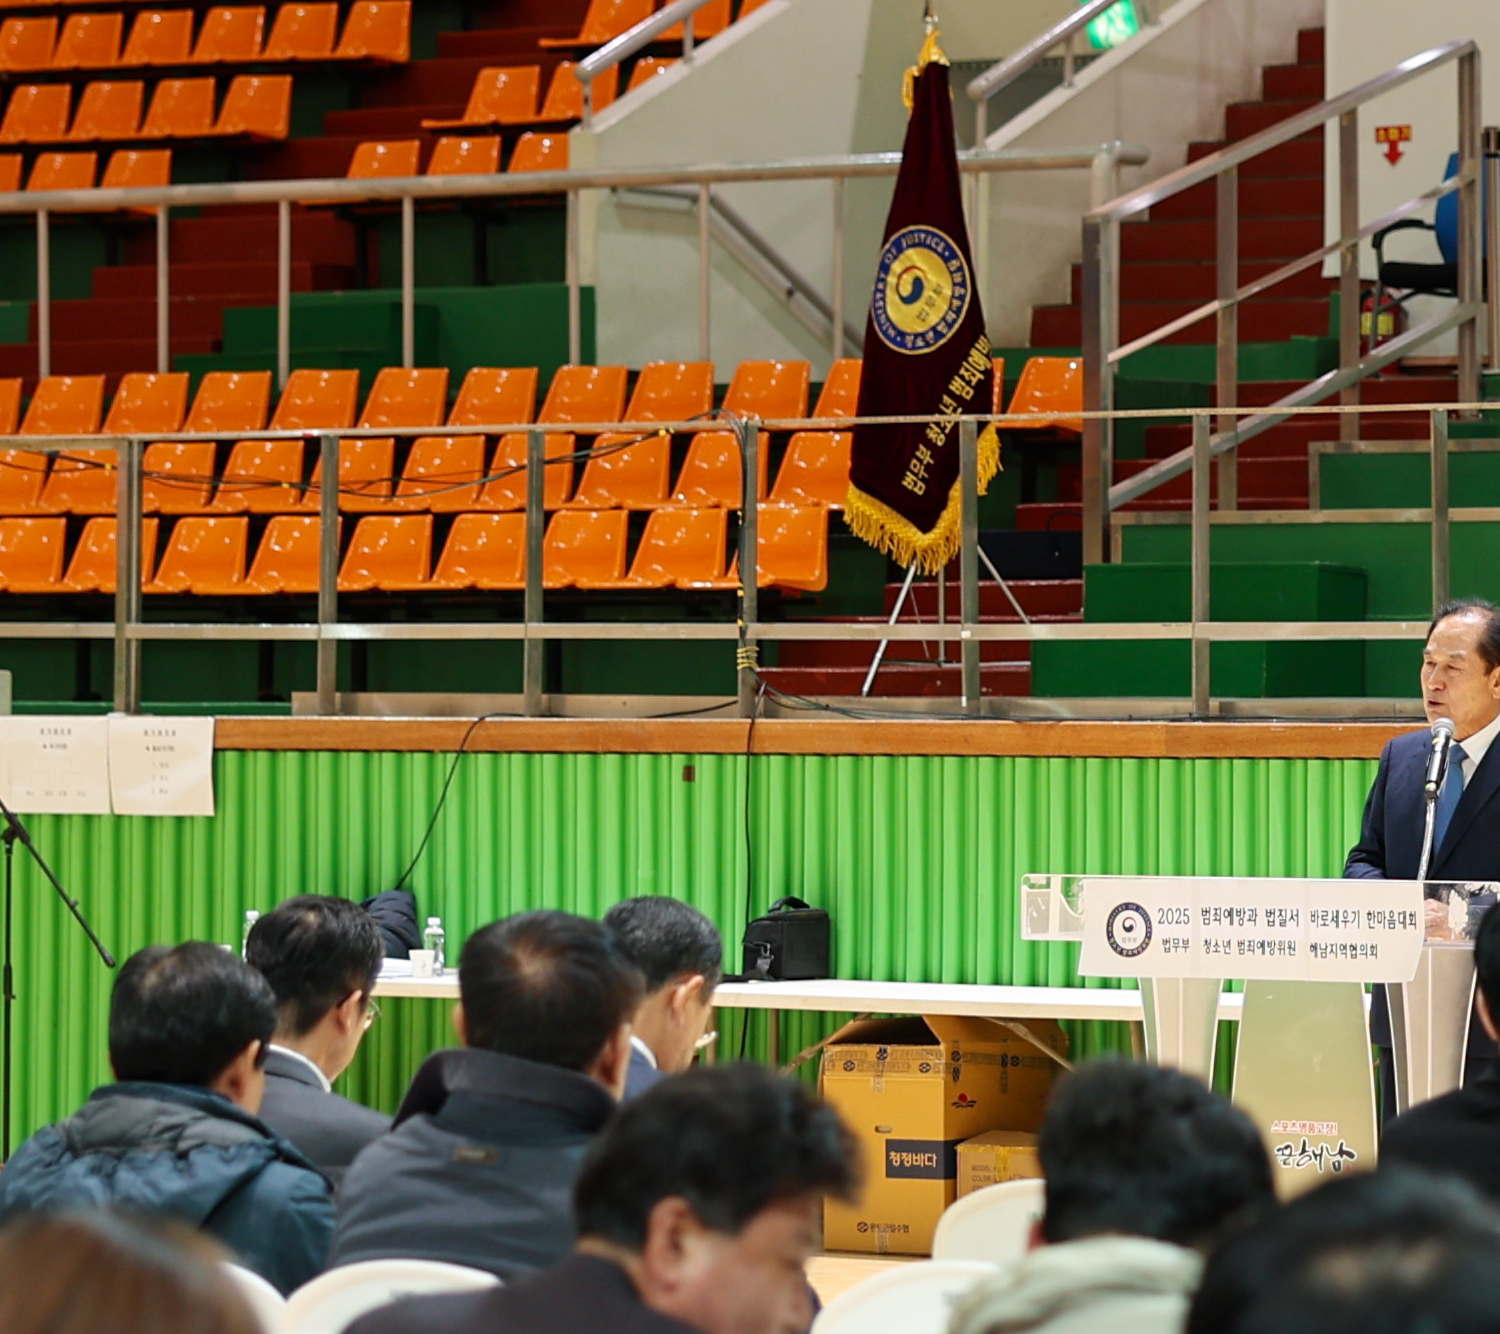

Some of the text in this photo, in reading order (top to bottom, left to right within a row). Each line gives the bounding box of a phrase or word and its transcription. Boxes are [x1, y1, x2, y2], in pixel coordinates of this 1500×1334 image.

[902, 444, 934, 496] 법무부
[1158, 906, 1417, 931] 2025 범죄예방과 법질서 바로세우기 한마음대회
[1162, 937, 1378, 959] 법무부 청소년 범죄예방위원 해남지역협의회
[889, 1150, 938, 1168] 청정바다
